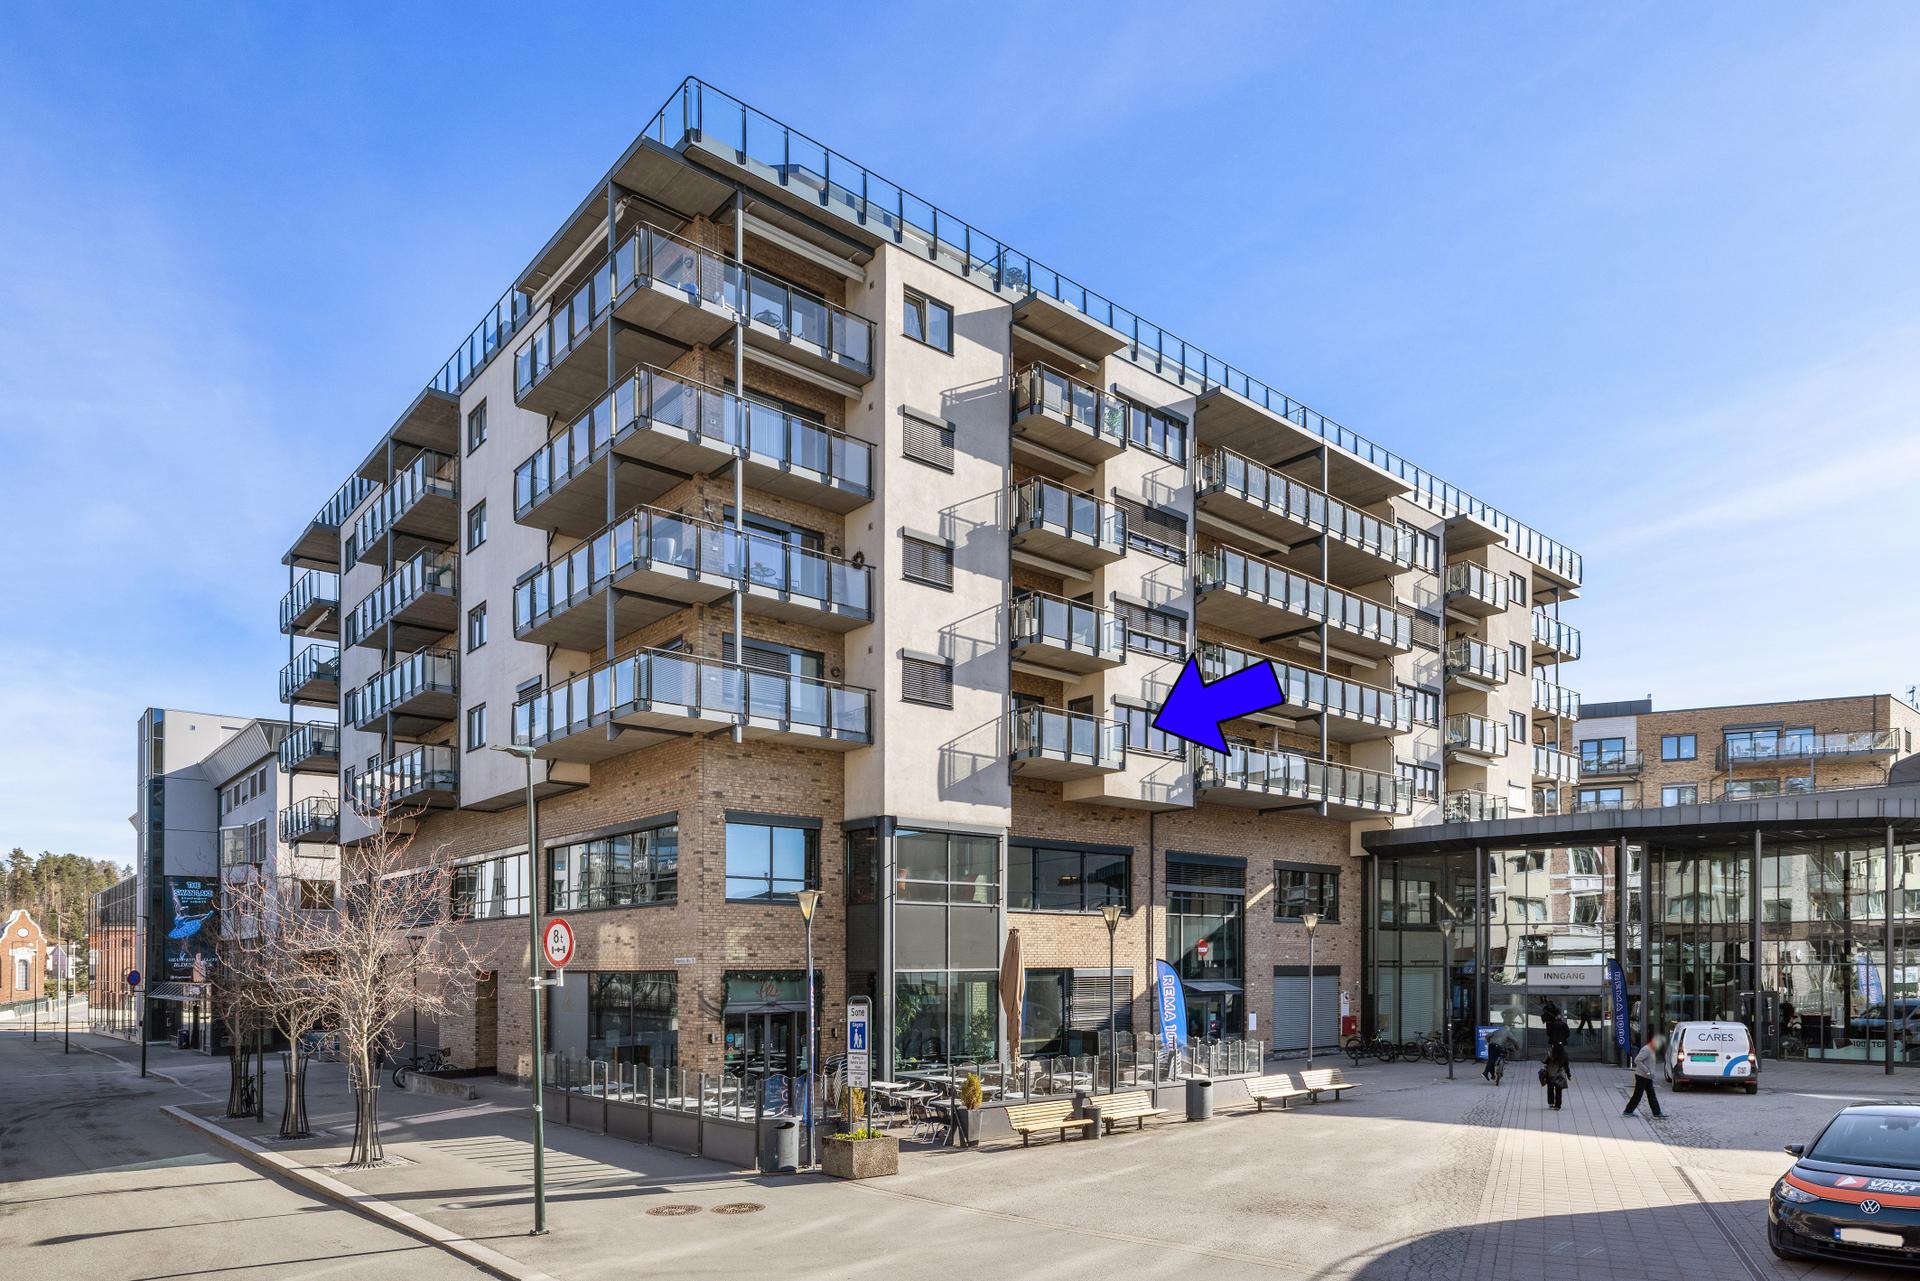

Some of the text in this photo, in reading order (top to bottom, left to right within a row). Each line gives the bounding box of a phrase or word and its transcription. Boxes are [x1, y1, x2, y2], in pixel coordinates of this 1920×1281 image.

[1543, 972, 1585, 980] INNGANG
[1163, 975, 1177, 1021] REMA
[850, 1007, 865, 1017] Sone
